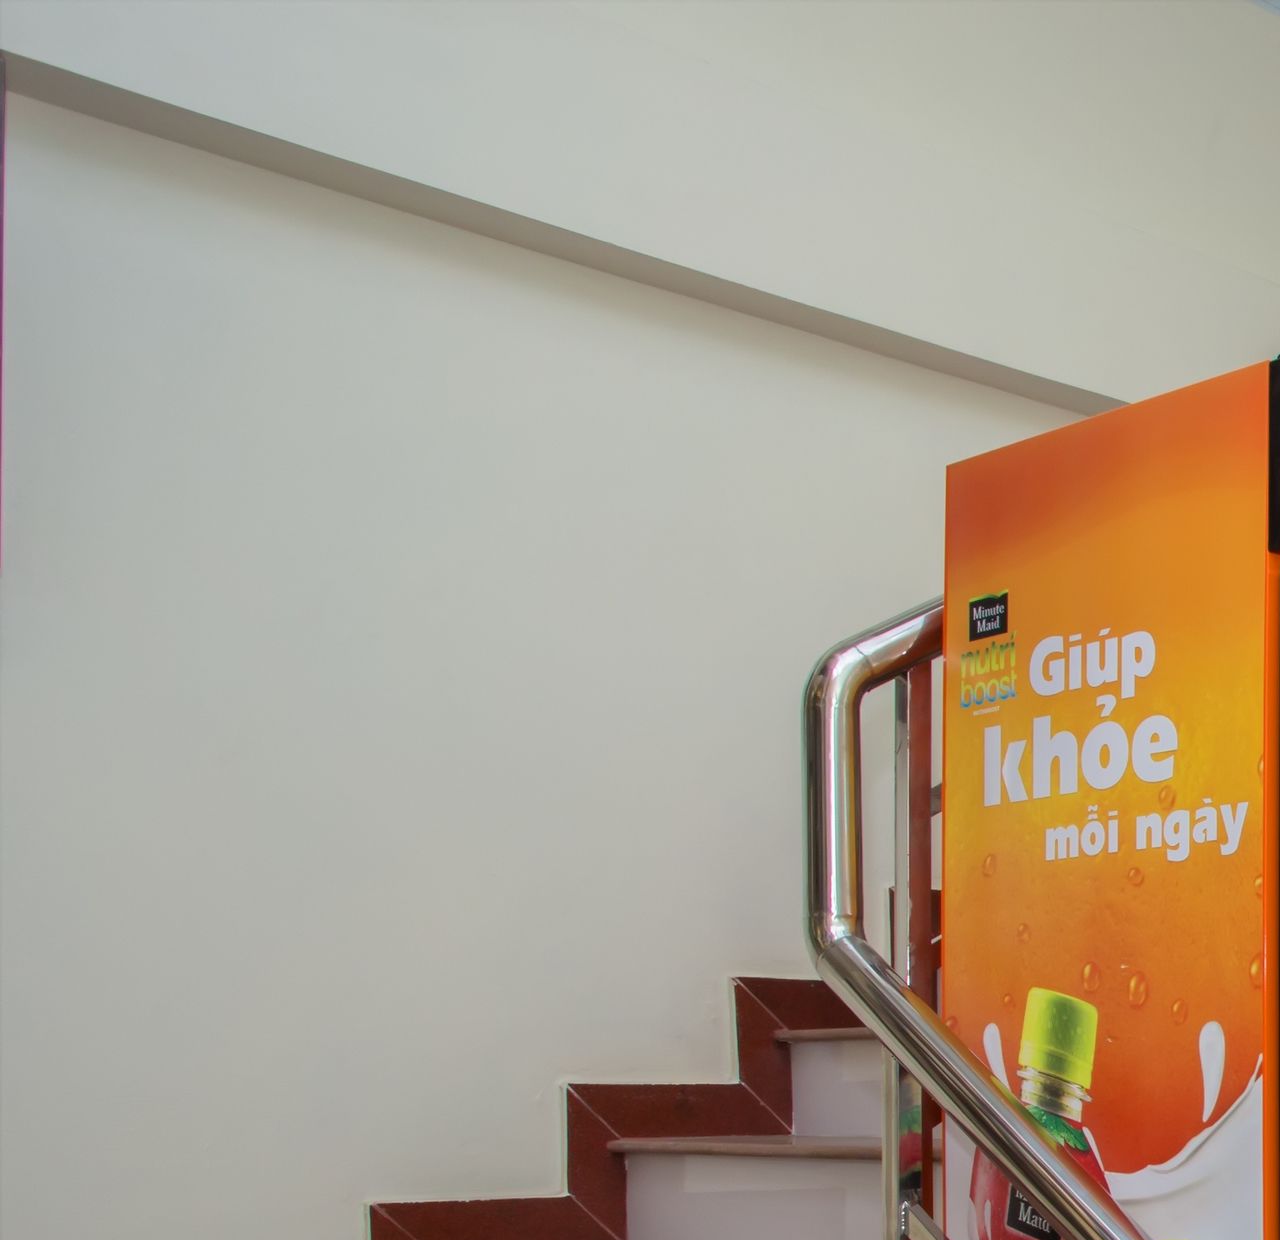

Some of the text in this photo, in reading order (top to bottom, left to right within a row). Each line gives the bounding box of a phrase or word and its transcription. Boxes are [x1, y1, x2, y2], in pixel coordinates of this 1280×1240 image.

[972, 604, 1005, 622] Minute
[977, 614, 1000, 633] Maid
[1029, 628, 1156, 700] Giúp
[960, 672, 1018, 709] boost
[983, 694, 1179, 807] khỏe
[1045, 797, 1249, 863] mỗi ngày
